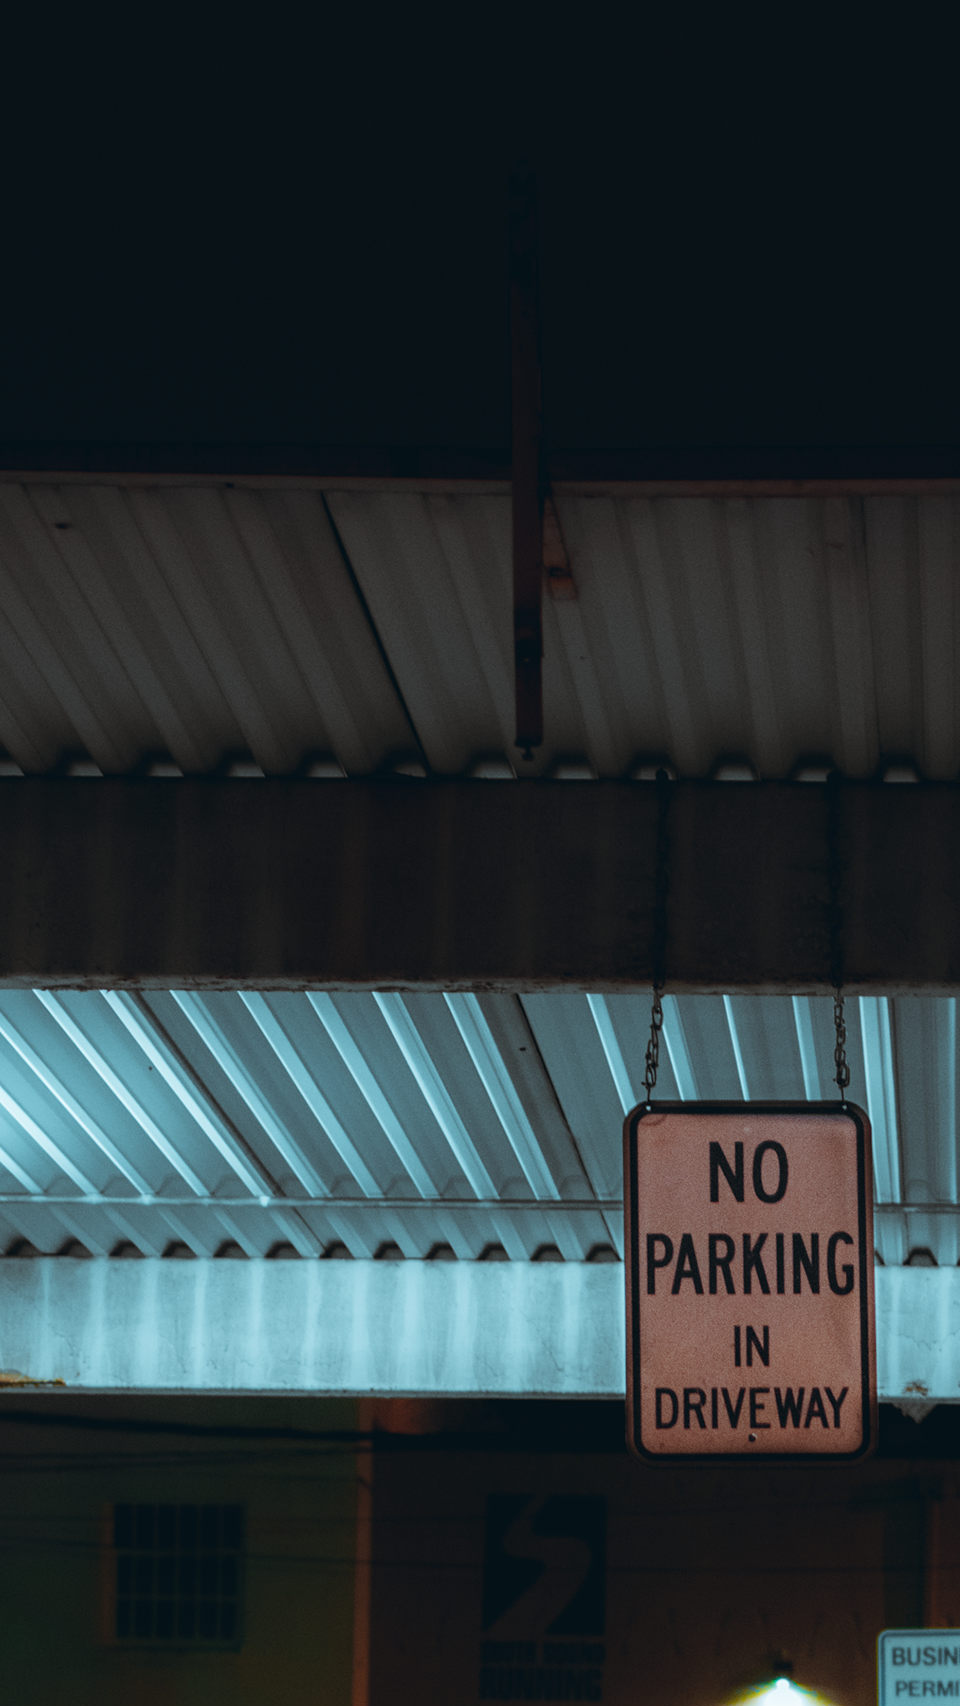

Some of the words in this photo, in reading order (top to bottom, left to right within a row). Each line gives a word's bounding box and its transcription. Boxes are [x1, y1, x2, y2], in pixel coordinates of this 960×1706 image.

[708, 1139, 789, 1204] NO
[645, 1230, 855, 1296] PARKING
[733, 1324, 770, 1368] IN
[654, 1386, 850, 1430] DRIVEWAY
